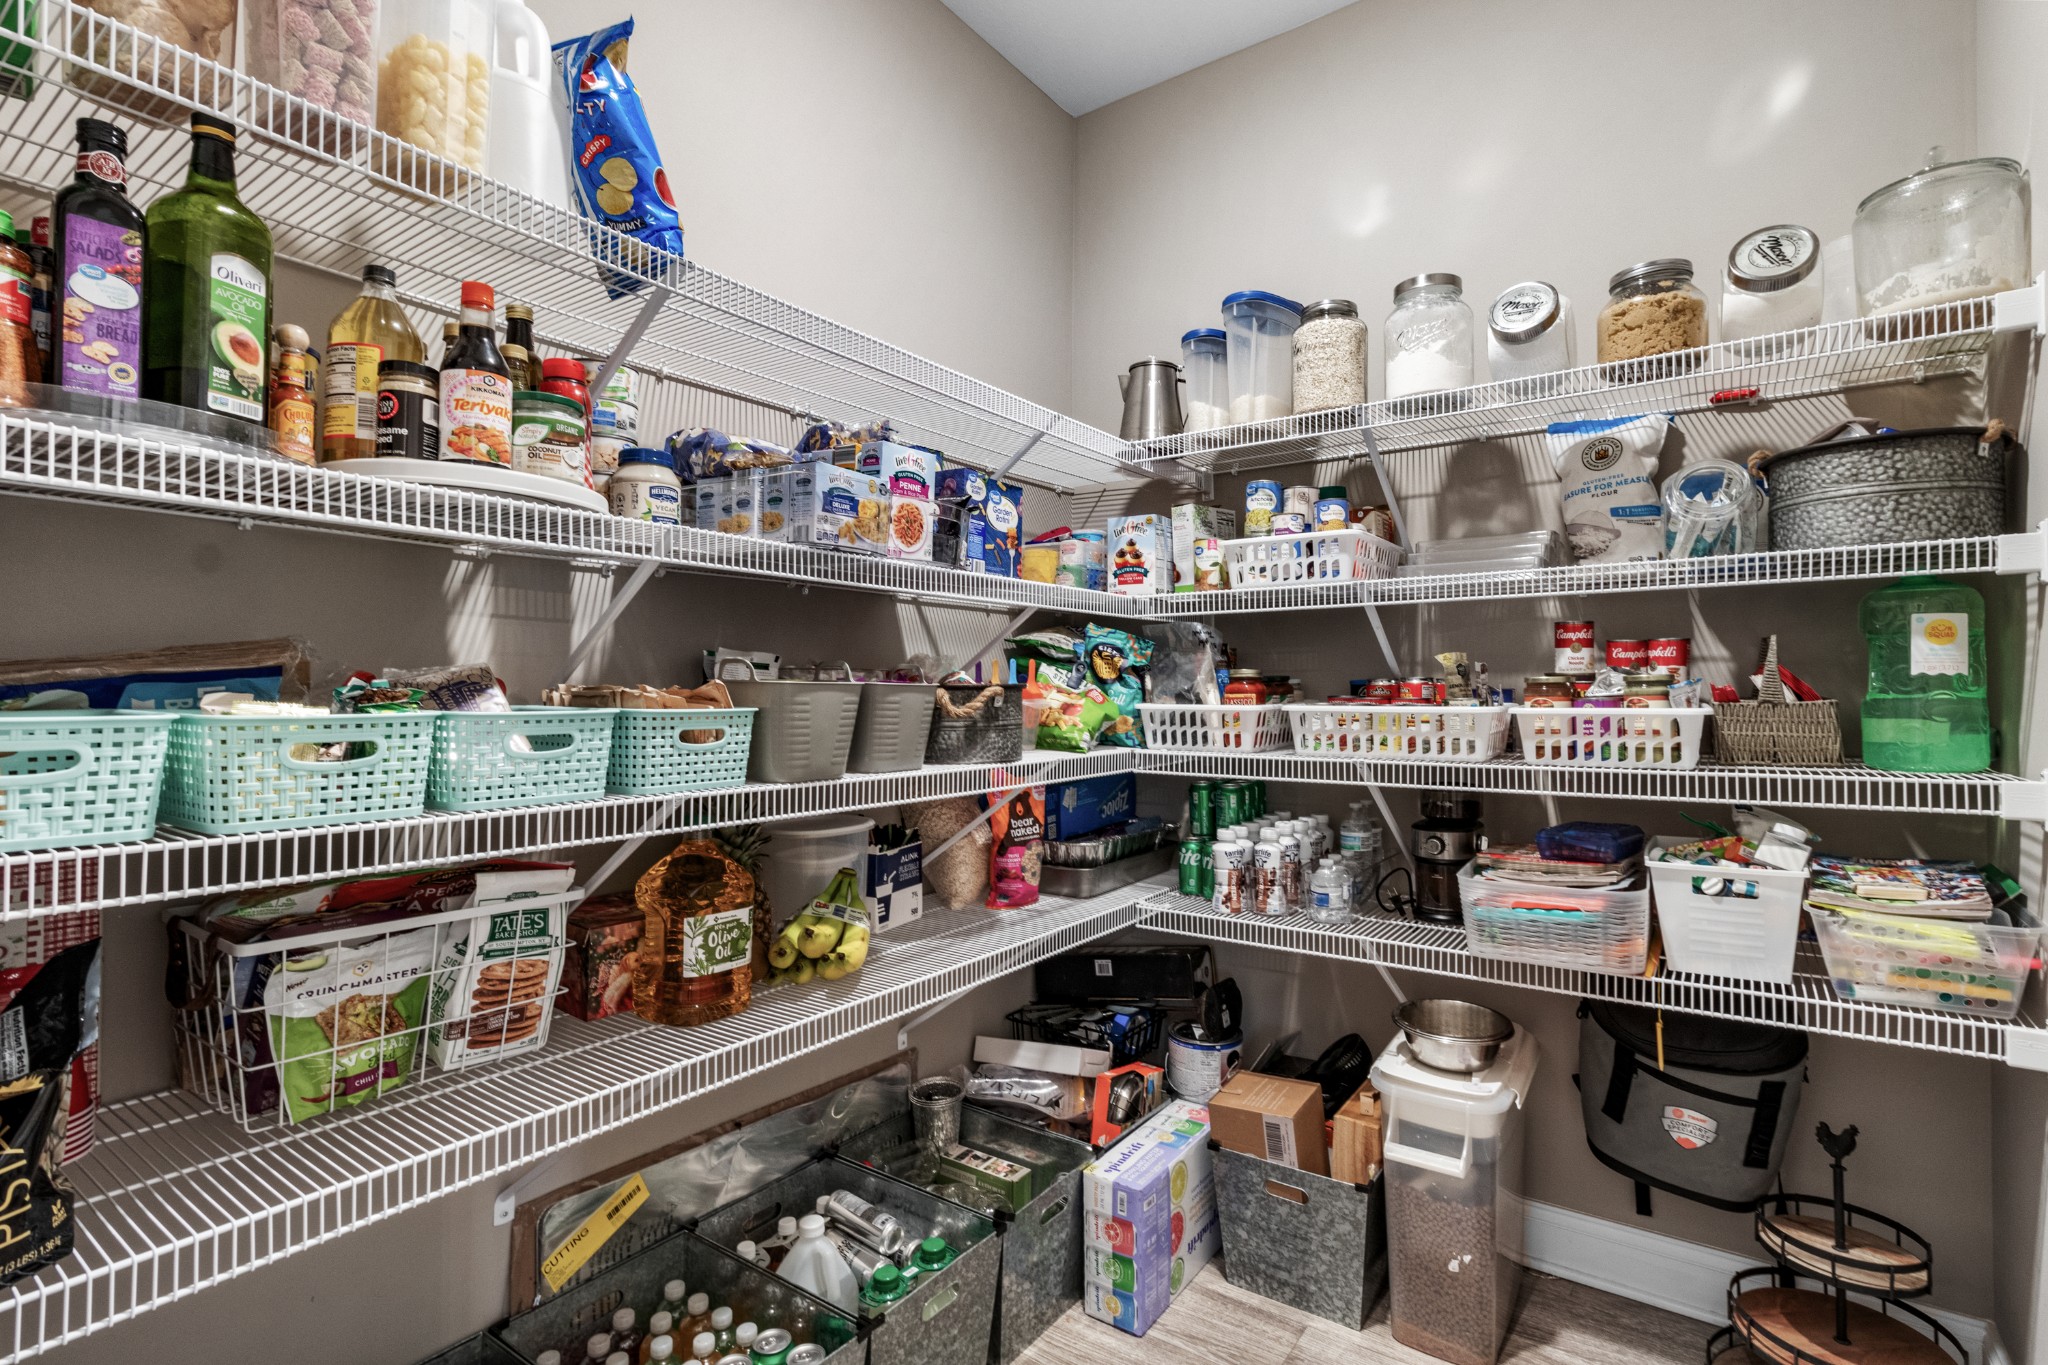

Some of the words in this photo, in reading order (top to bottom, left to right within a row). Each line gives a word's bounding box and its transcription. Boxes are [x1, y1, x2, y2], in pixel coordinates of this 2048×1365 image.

[582, 137, 608, 166] CRISPY
[607, 218, 643, 232] YUMMY
[69, 239, 122, 264] SALADS
[217, 265, 262, 293] Olivari
[215, 287, 263, 312] AVOCADO
[1501, 298, 1545, 313] Mason
[231, 302, 247, 315] OIL
[96, 322, 138, 346] BREAD
[470, 385, 506, 398] KIKKOMAN
[555, 423, 579, 437] ORGANIC
[527, 445, 562, 456] COCONUT
[527, 452, 543, 460] OIL
[899, 480, 922, 493] PENNE
[1582, 473, 1624, 486] GLUTEN-FREE
[1594, 482, 1613, 491] FOR
[1591, 489, 1619, 498] FLOUR
[655, 504, 676, 514] VEGAN
[832, 501, 851, 511] DELUXE
[992, 505, 1013, 517] Garden
[995, 513, 1011, 524] Rotini
[1928, 631, 1955, 639] SQUAD
[1101, 789, 1129, 819] Ziploc
[1011, 817, 1034, 829] bear
[1010, 824, 1040, 838] naked
[900, 851, 919, 863] ALINK
[494, 913, 545, 933] TATE'S
[495, 930, 515, 939] BAKE
[518, 929, 539, 938] SHOP
[707, 928, 741, 948] Olive
[714, 942, 733, 960] Oil
[297, 967, 418, 1000] CRUNCHMASTER
[12, 1008, 23, 1047] Nutrition
[17, 1047, 25, 1075] Facts
[329, 1035, 410, 1075] AVOCADO
[354, 1074, 375, 1087] CHILI
[1667, 1124, 1711, 1140] SPECIALIST
[1670, 1120, 1708, 1134] COMFORT
[1103, 1141, 1146, 1174] spindrift
[543, 1226, 590, 1276] CUTTING
